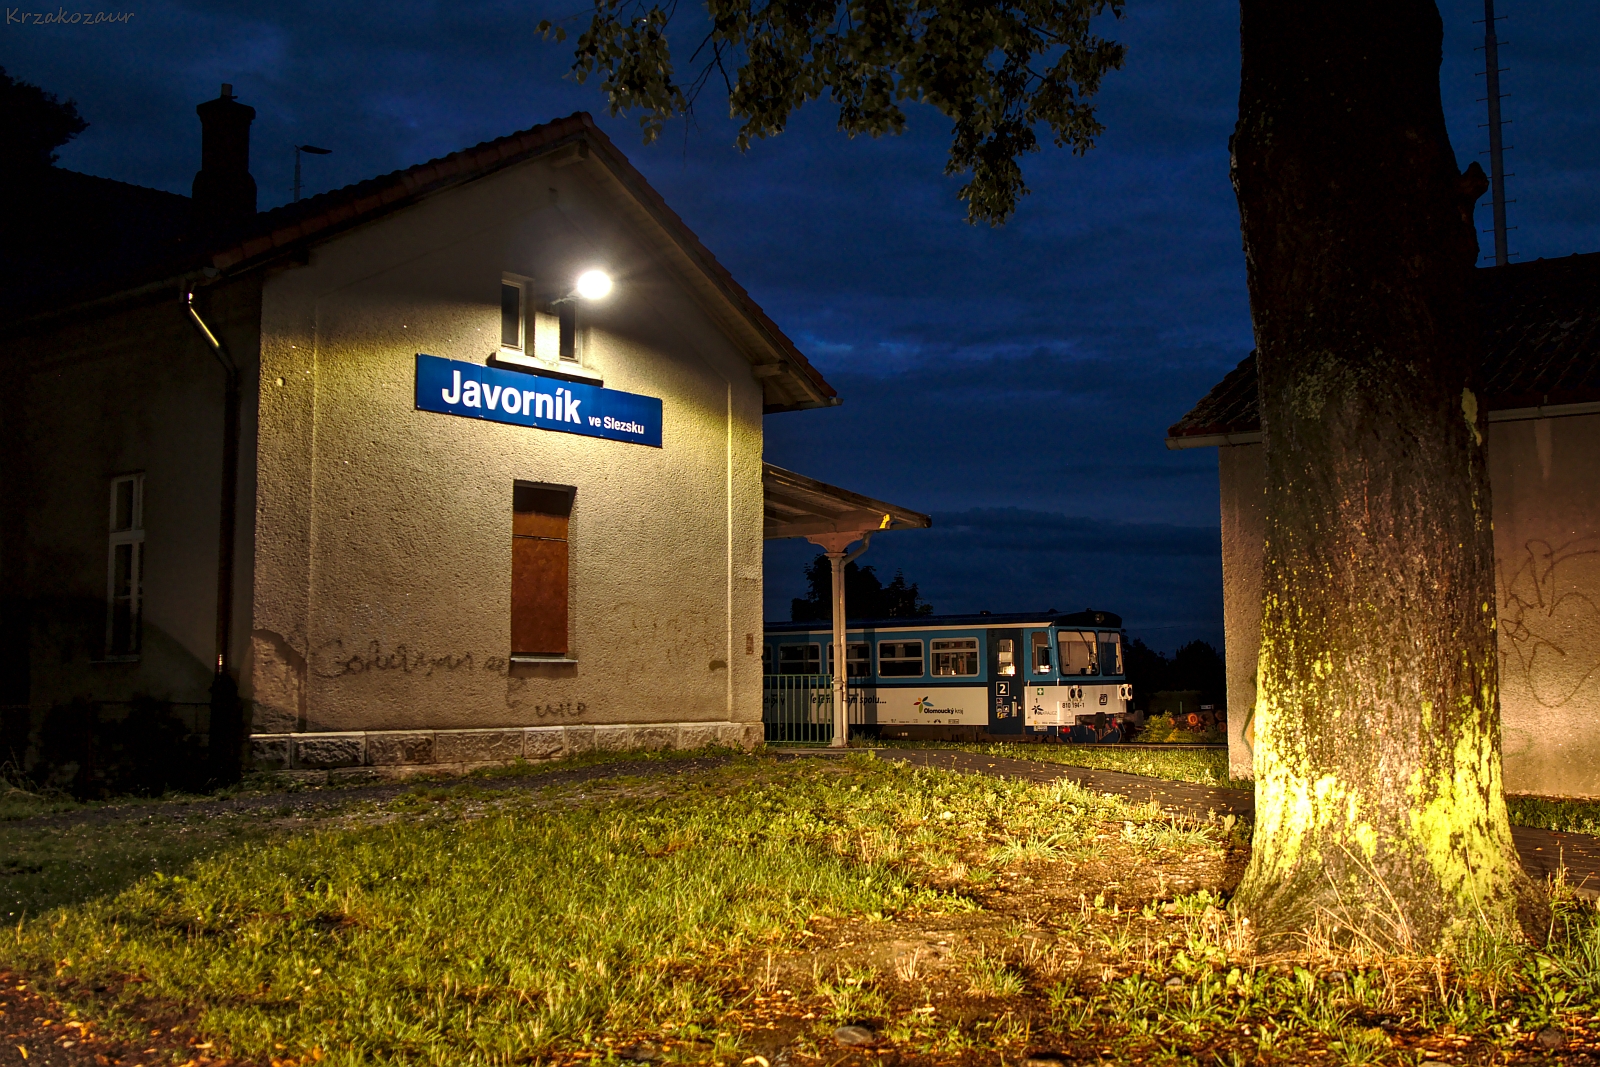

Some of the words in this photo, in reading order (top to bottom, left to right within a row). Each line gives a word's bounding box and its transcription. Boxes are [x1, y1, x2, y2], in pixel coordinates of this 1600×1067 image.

[441, 370, 582, 424] Javorník
[588, 415, 601, 427] ve
[603, 416, 645, 435] Slezsku
[999, 683, 1007, 694] 2
[924, 707, 954, 715] Olomoucký
